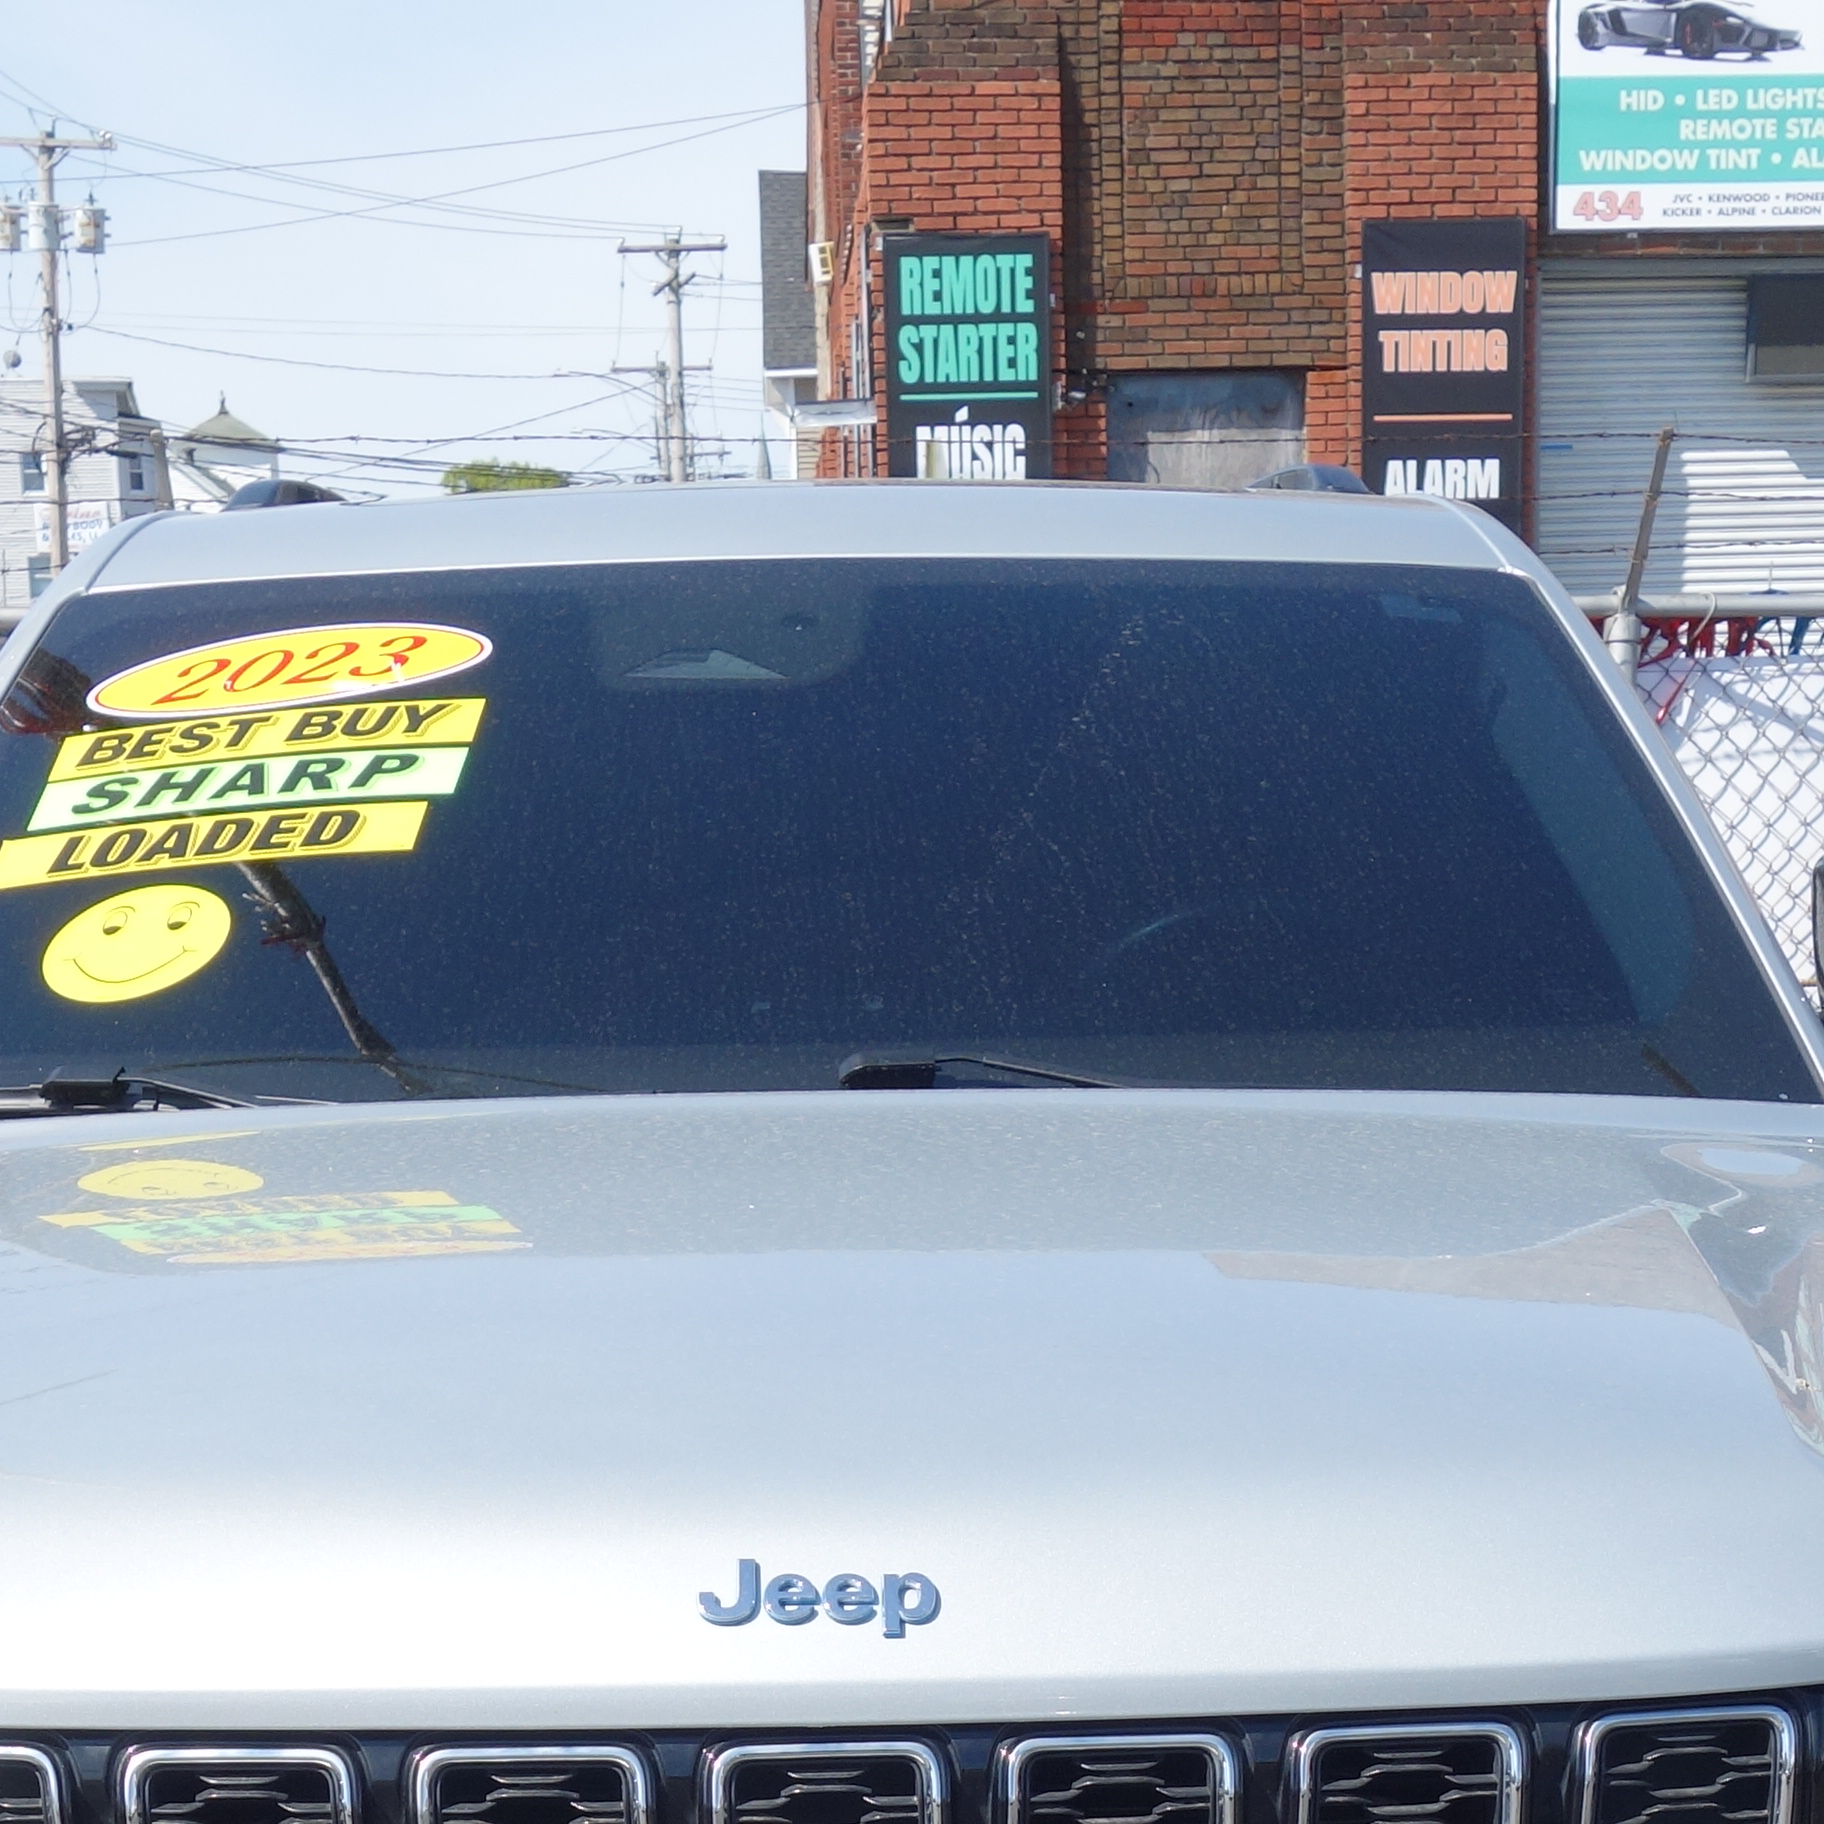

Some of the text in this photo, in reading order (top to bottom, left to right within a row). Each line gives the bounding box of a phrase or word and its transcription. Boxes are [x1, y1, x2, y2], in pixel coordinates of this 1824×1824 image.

[1620, 89, 1665, 111] HID
[1696, 88, 1744, 110] LED
[1680, 117, 1778, 140] REMOTE
[1580, 149, 1700, 171] WINDOW
[1706, 149, 1761, 170] TINT
[1573, 190, 1644, 222] 434
[1663, 206, 1702, 217] KICKER
[1717, 206, 1757, 217] ALPINE
[1771, 205, 1822, 216] CLARION
[1673, 193, 1693, 204] JVC
[1708, 192, 1771, 203] KENWOOD
[900, 254, 1035, 315] REMOTE
[1371, 270, 1517, 314] WINDOW
[898, 323, 1038, 383] STARTER
[1378, 329, 1508, 372] TINTING
[1384, 458, 1500, 499] ALARM
[150, 635, 428, 706] 2023
[76, 703, 462, 768] BEST BUY
[71, 753, 423, 815] SHARP
[46, 809, 366, 878] LOADED
[696, 1558, 941, 1639] Jeep
